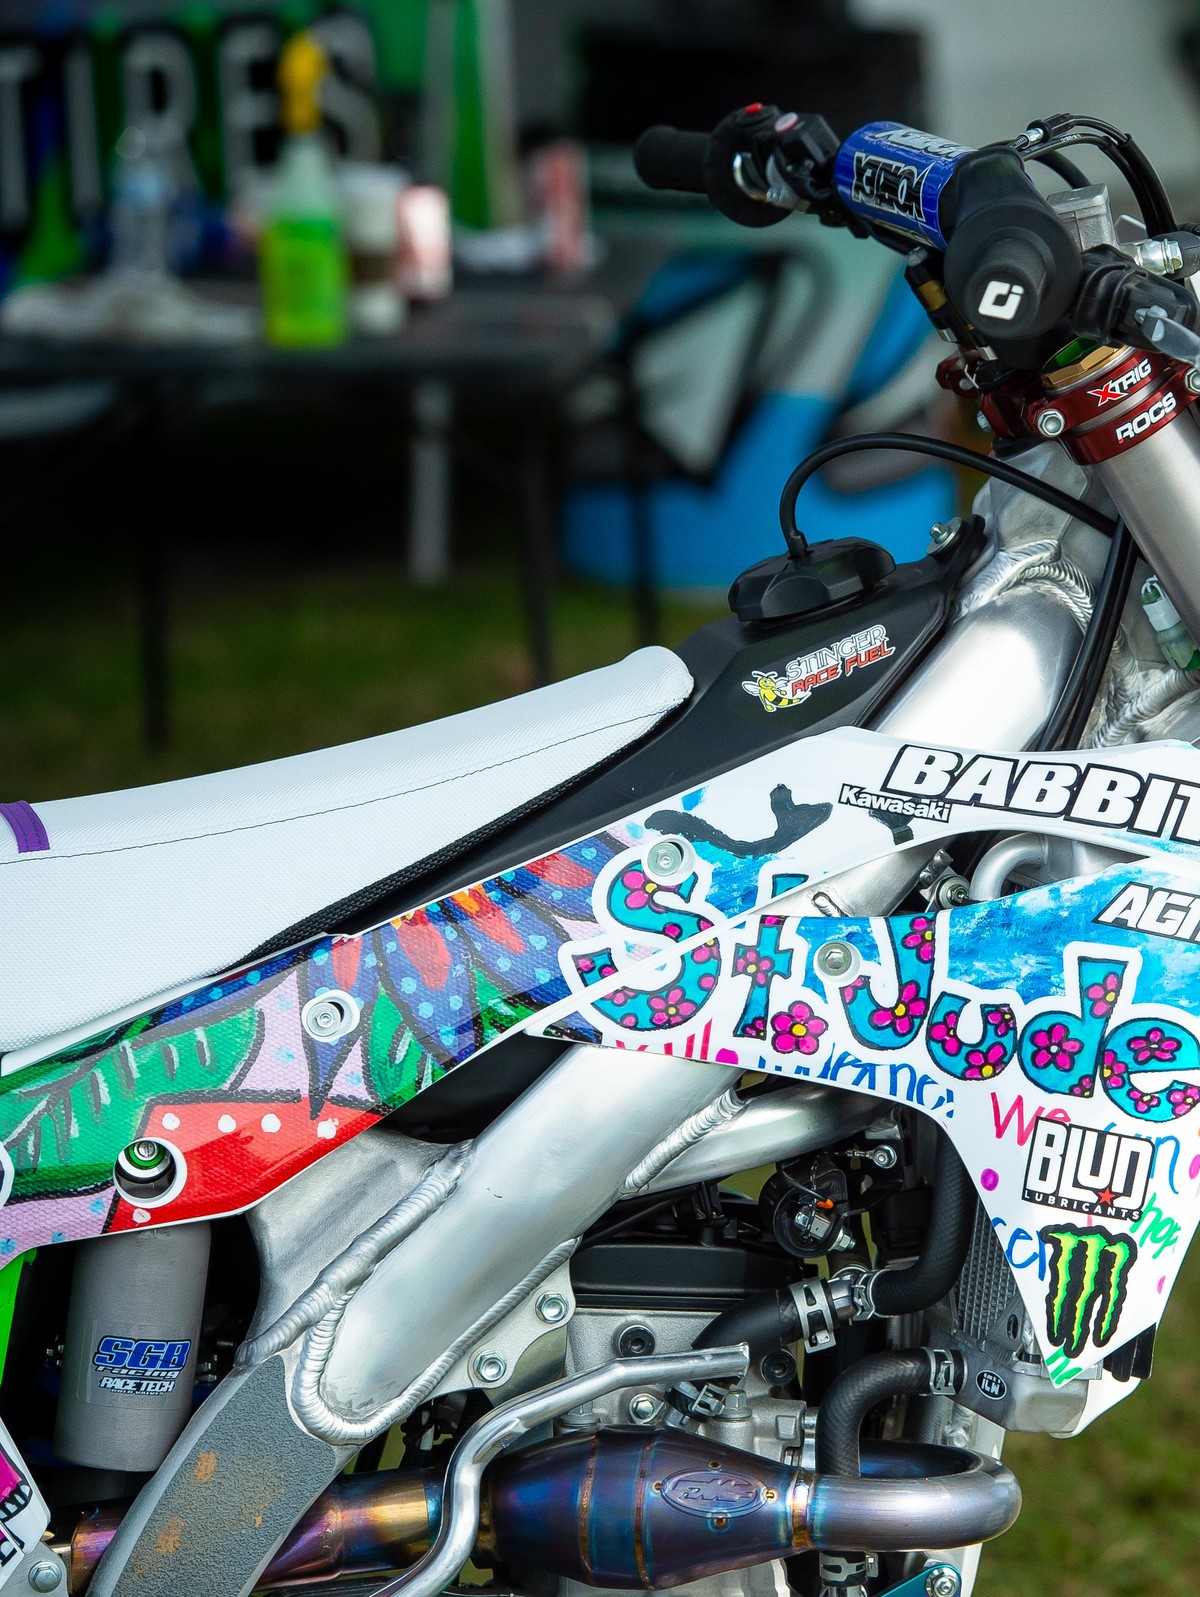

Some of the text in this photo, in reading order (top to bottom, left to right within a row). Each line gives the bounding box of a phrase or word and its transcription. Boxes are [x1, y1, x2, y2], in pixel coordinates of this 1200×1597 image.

[1086, 358, 1152, 407] XTRIG
[1115, 391, 1177, 444] ROCS
[785, 624, 889, 680] STINGER
[792, 641, 896, 697] RACE FUEL
[839, 784, 952, 824] Kawasaki
[1024, 1189, 1142, 1220] LUBRICANTS
[94, 1336, 191, 1371] SGB
[96, 1366, 181, 1379] racing
